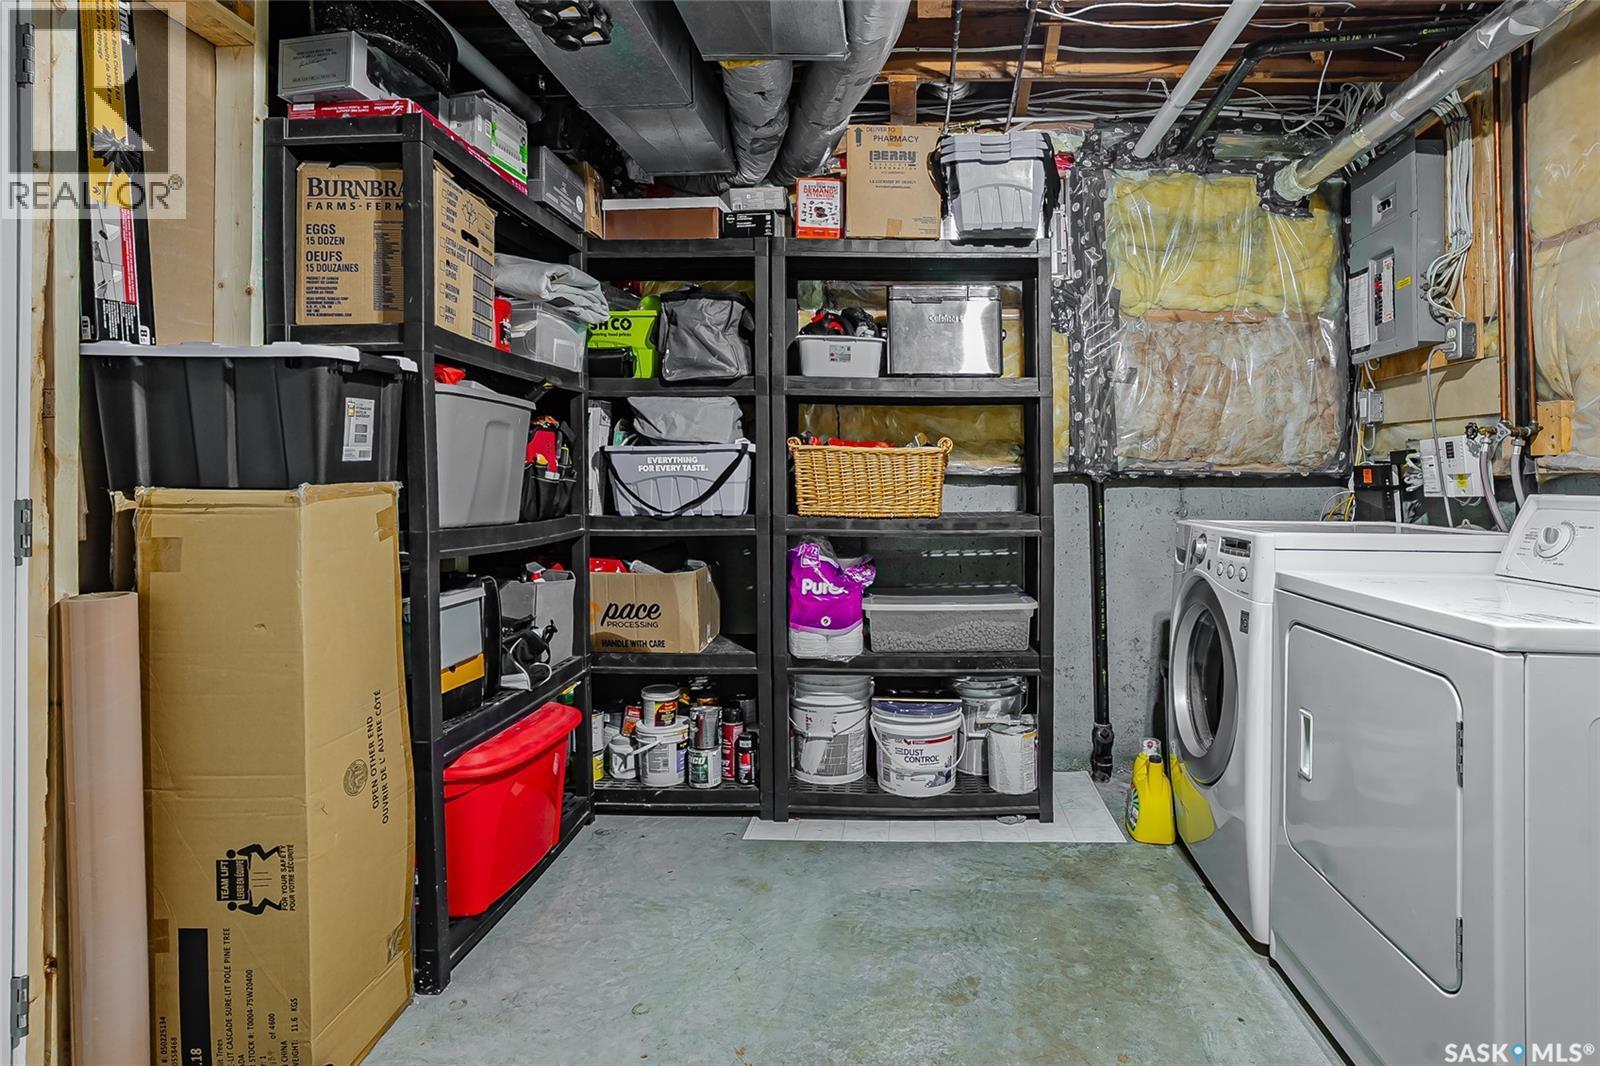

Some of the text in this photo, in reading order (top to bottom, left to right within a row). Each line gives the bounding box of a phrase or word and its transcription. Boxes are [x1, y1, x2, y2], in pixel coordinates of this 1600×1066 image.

[306, 224, 336, 235] EGGS
[306, 237, 345, 245] 15 DOZEN
[306, 251, 342, 262] OEUFS
[306, 264, 359, 272] 15 DOUZAINES
[682, 464, 708, 472] TASTE.
[601, 602, 662, 626] pace
[602, 640, 666, 648] HANDLE WITH CARE
[372, 689, 382, 717] CÔTÉ
[375, 719, 385, 753] AUTRE
[366, 716, 380, 810] OPEN OTHER END
[904, 755, 940, 763] CONTROL
[379, 767, 388, 781] DE
[380, 783, 390, 825] OUVRIR
[287, 845, 295, 873] SÉCURITÉ
[220, 861, 229, 900] TEAM LIFT
[288, 894, 296, 911] POUR
[222, 928, 230, 945] TREE
[223, 947, 231, 964] PINE
[223, 965, 231, 983] POLE
[224, 986, 233, 1016] SURE-LIT
[290, 998, 298, 1012] KGS
[291, 1017, 299, 1032] 11.6
[160, 1017, 168, 1055] 050225134
[225, 1019, 234, 1050] CASCADE
[269, 1032, 277, 1040] of
[248, 1041, 256, 1062] STOCK
[280, 1040, 289, 1063] CHINA
